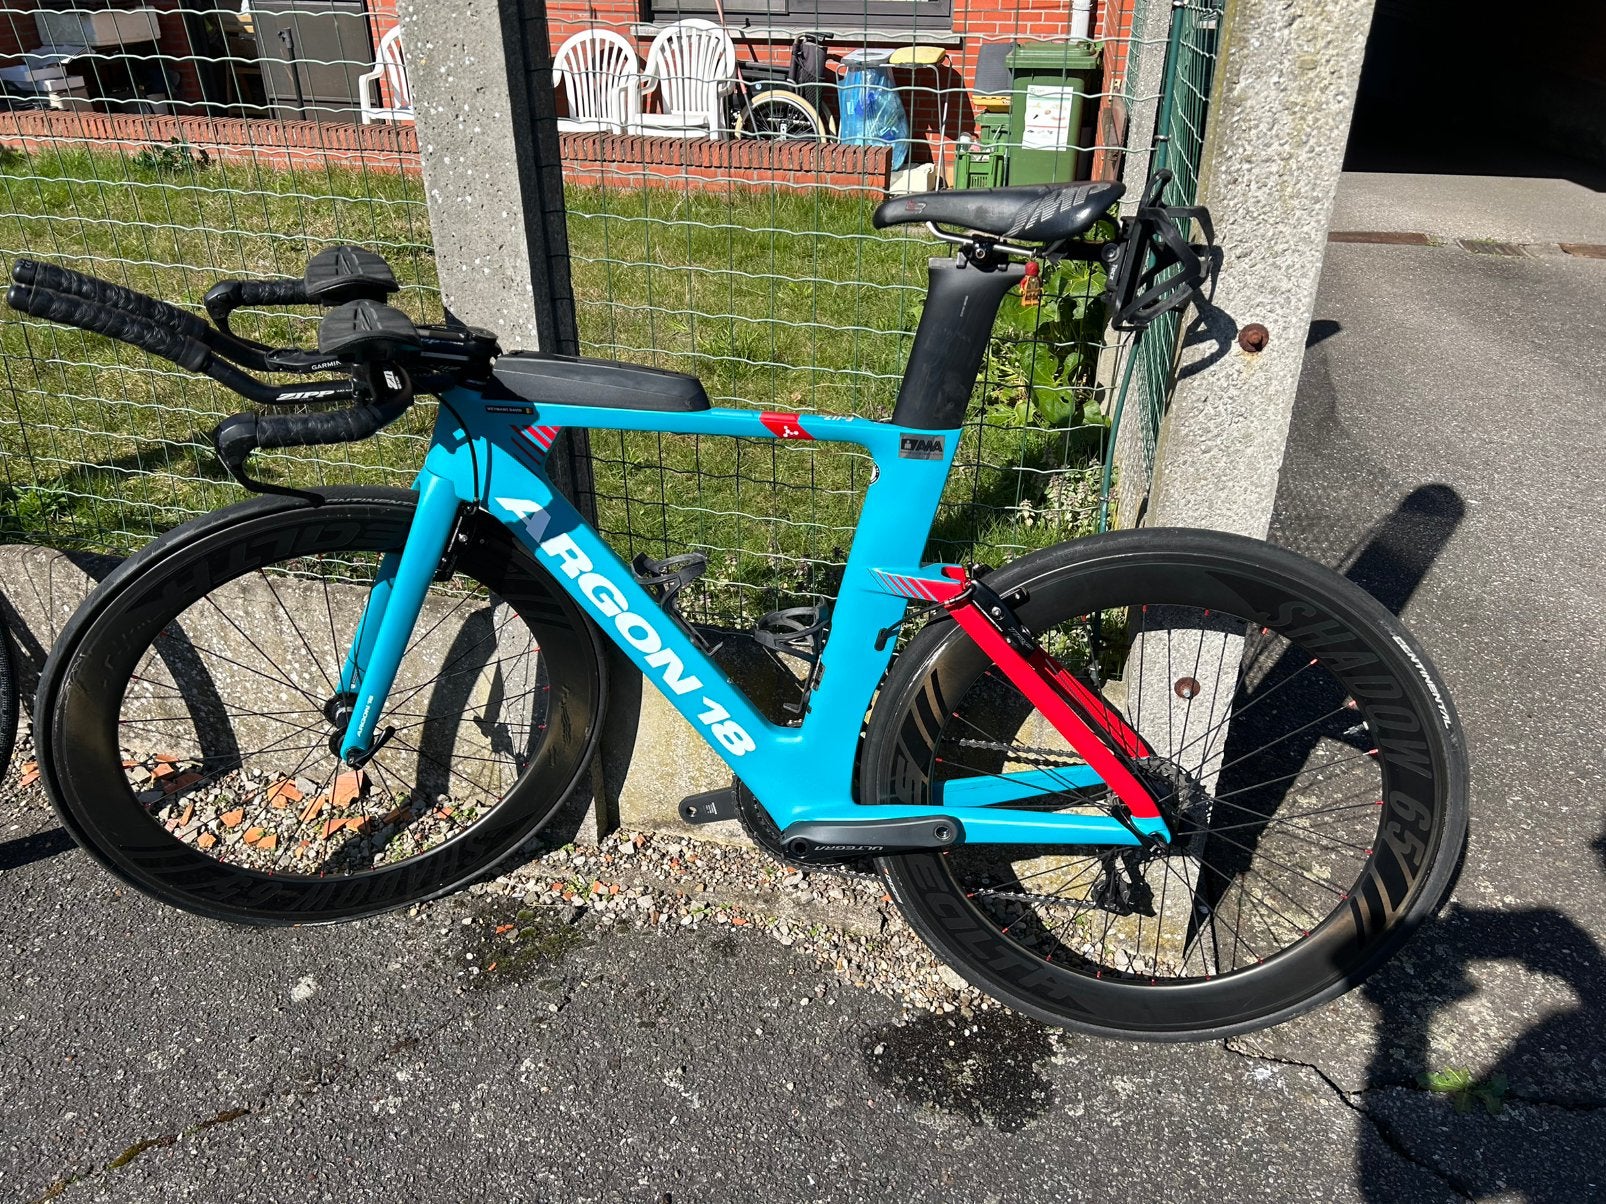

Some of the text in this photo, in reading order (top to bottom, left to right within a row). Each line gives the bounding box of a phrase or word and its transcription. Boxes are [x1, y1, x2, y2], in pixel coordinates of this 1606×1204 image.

[276, 389, 335, 401] ZIPP
[494, 496, 757, 757] ARGON 18
[357, 705, 370, 737] ARGON
[1391, 633, 1452, 730] CONTINENTAL
[1262, 601, 1434, 867] SHADOW 65
